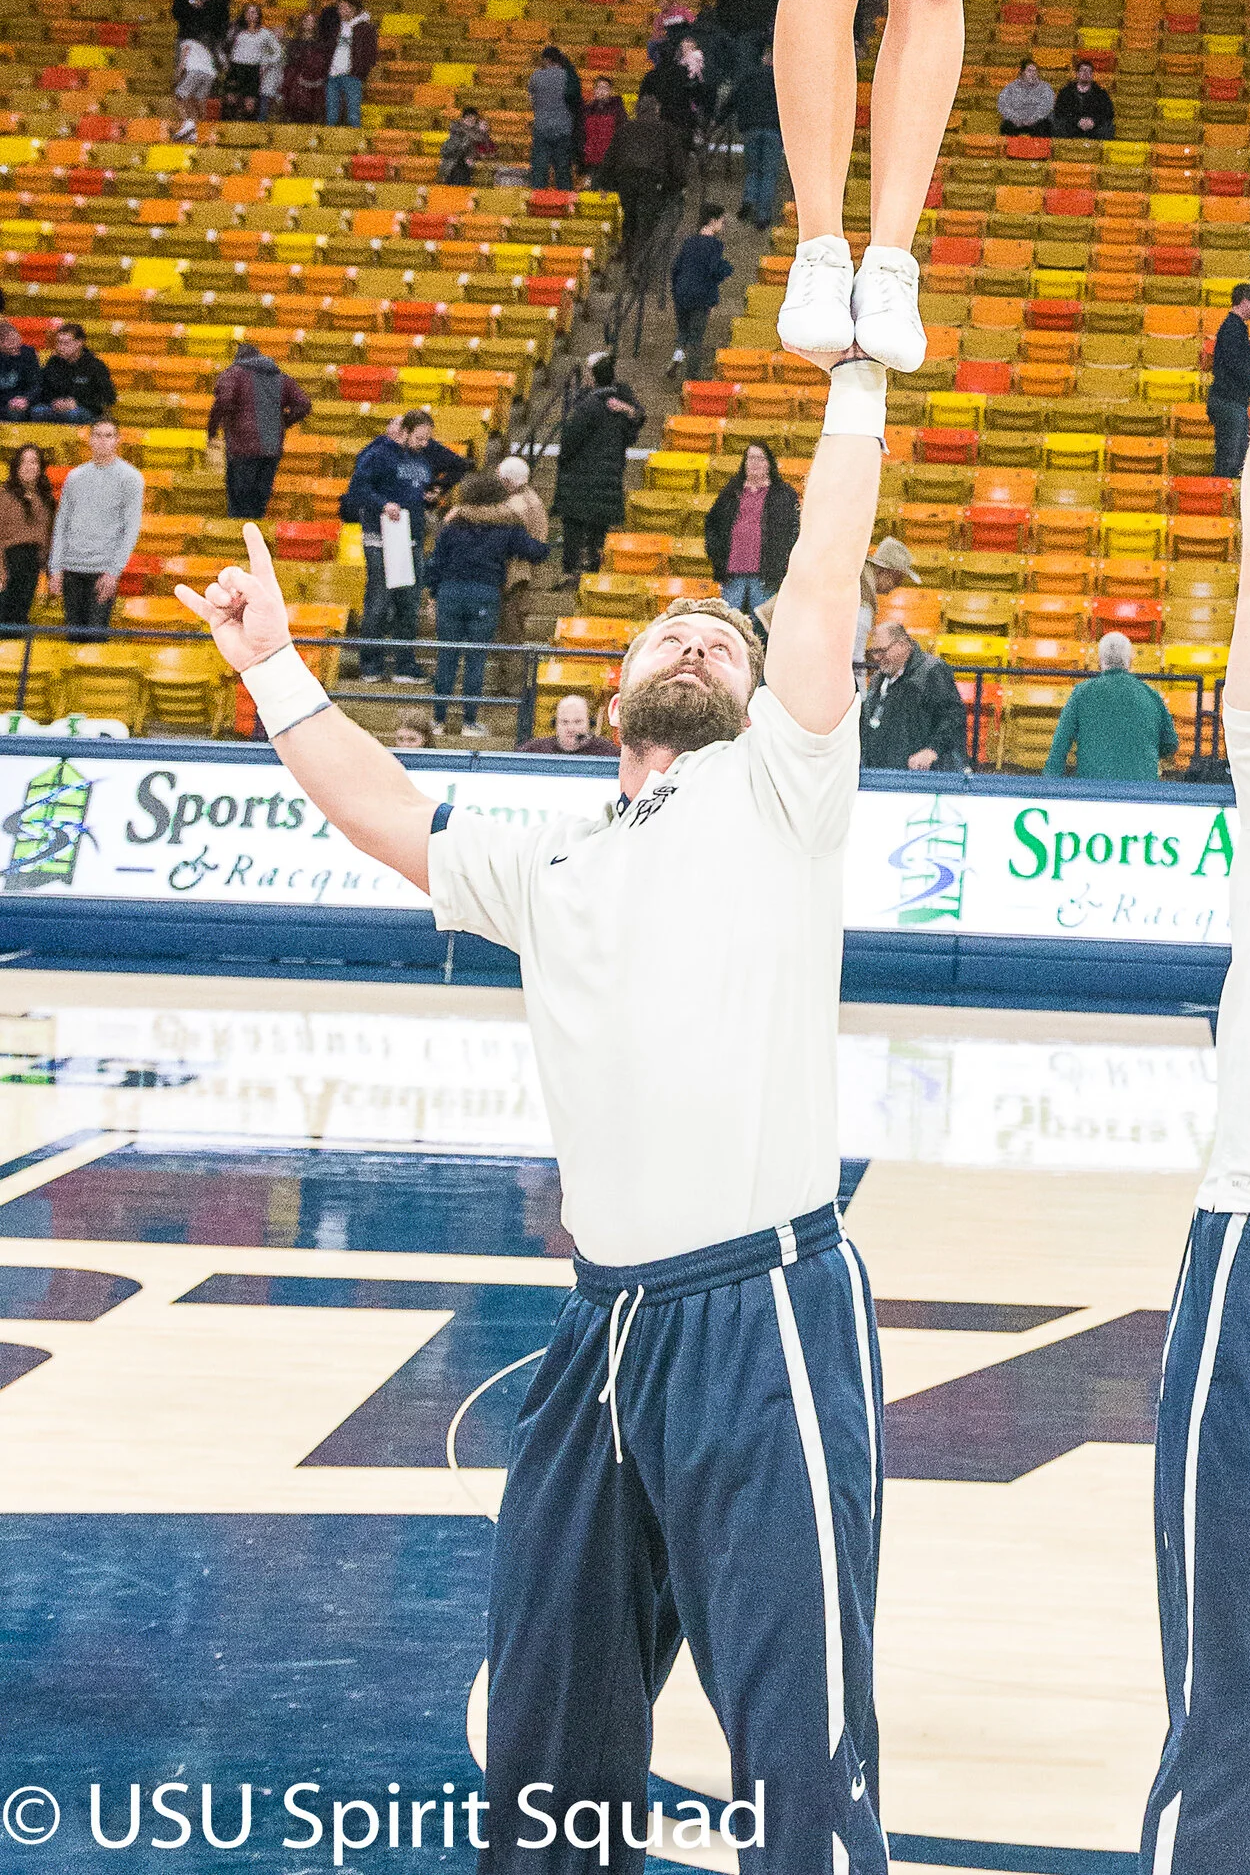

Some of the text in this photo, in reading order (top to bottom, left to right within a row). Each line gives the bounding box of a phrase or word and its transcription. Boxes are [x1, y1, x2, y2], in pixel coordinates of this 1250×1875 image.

[126, 770, 305, 845] Sports
[168, 845, 219, 891] &
[1008, 807, 1180, 880] Sports
[1111, 892, 1231, 941] Racq
